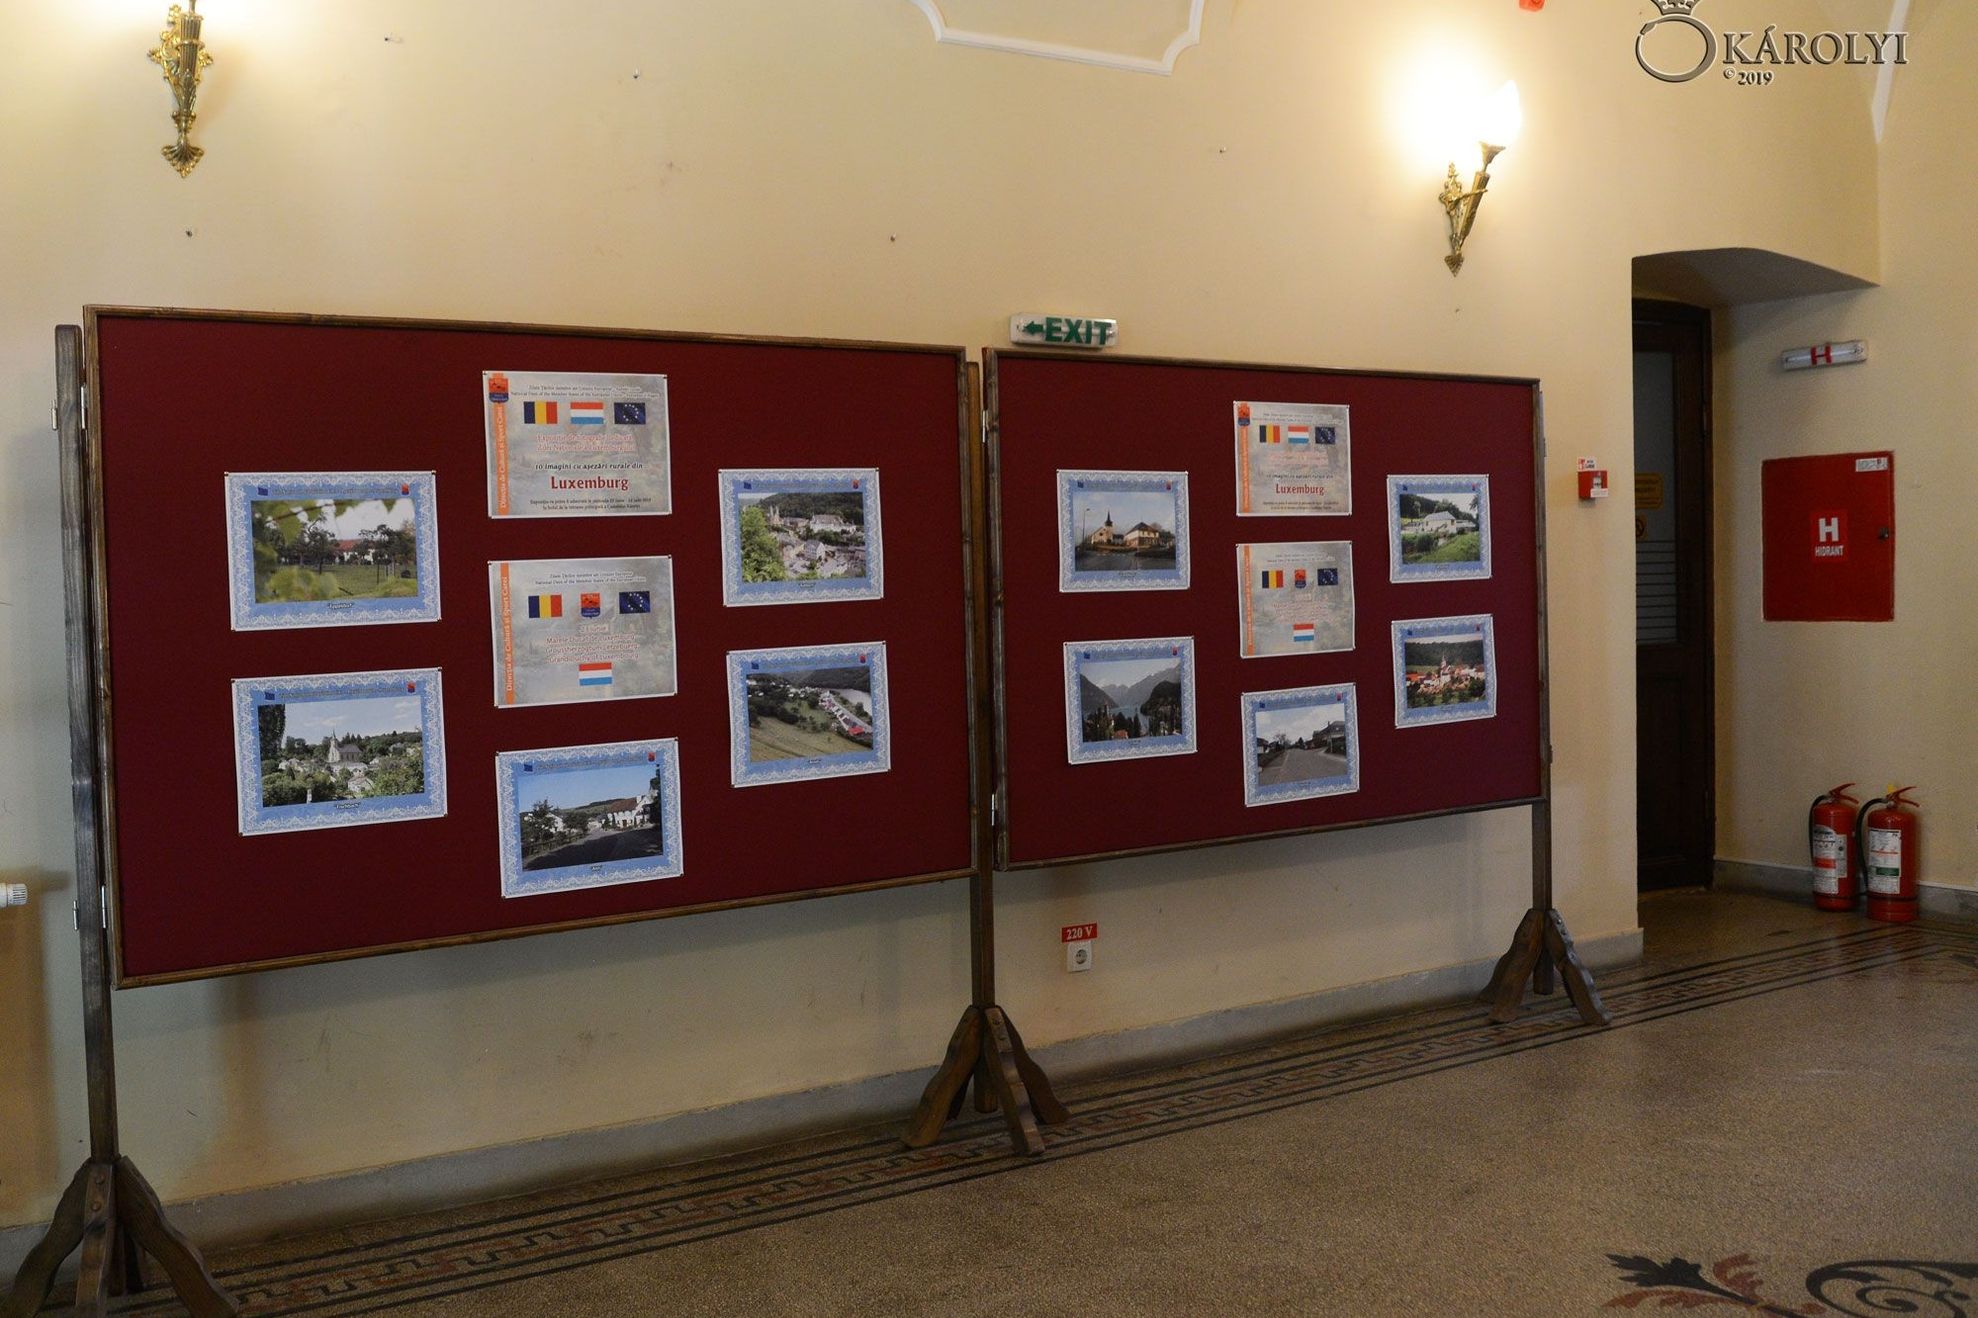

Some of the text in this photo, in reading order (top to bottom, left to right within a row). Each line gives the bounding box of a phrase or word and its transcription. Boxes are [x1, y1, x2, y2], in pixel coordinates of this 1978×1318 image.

[1045, 316, 1112, 346] EXIT
[1810, 344, 1833, 366] H
[545, 462, 571, 471] imagini
[551, 475, 629, 491] Luxemburg
[1275, 482, 1325, 497] Luxemburg
[1818, 517, 1839, 542] H
[1815, 545, 1844, 556] HIDRANT
[1066, 925, 1093, 940] 220 V
